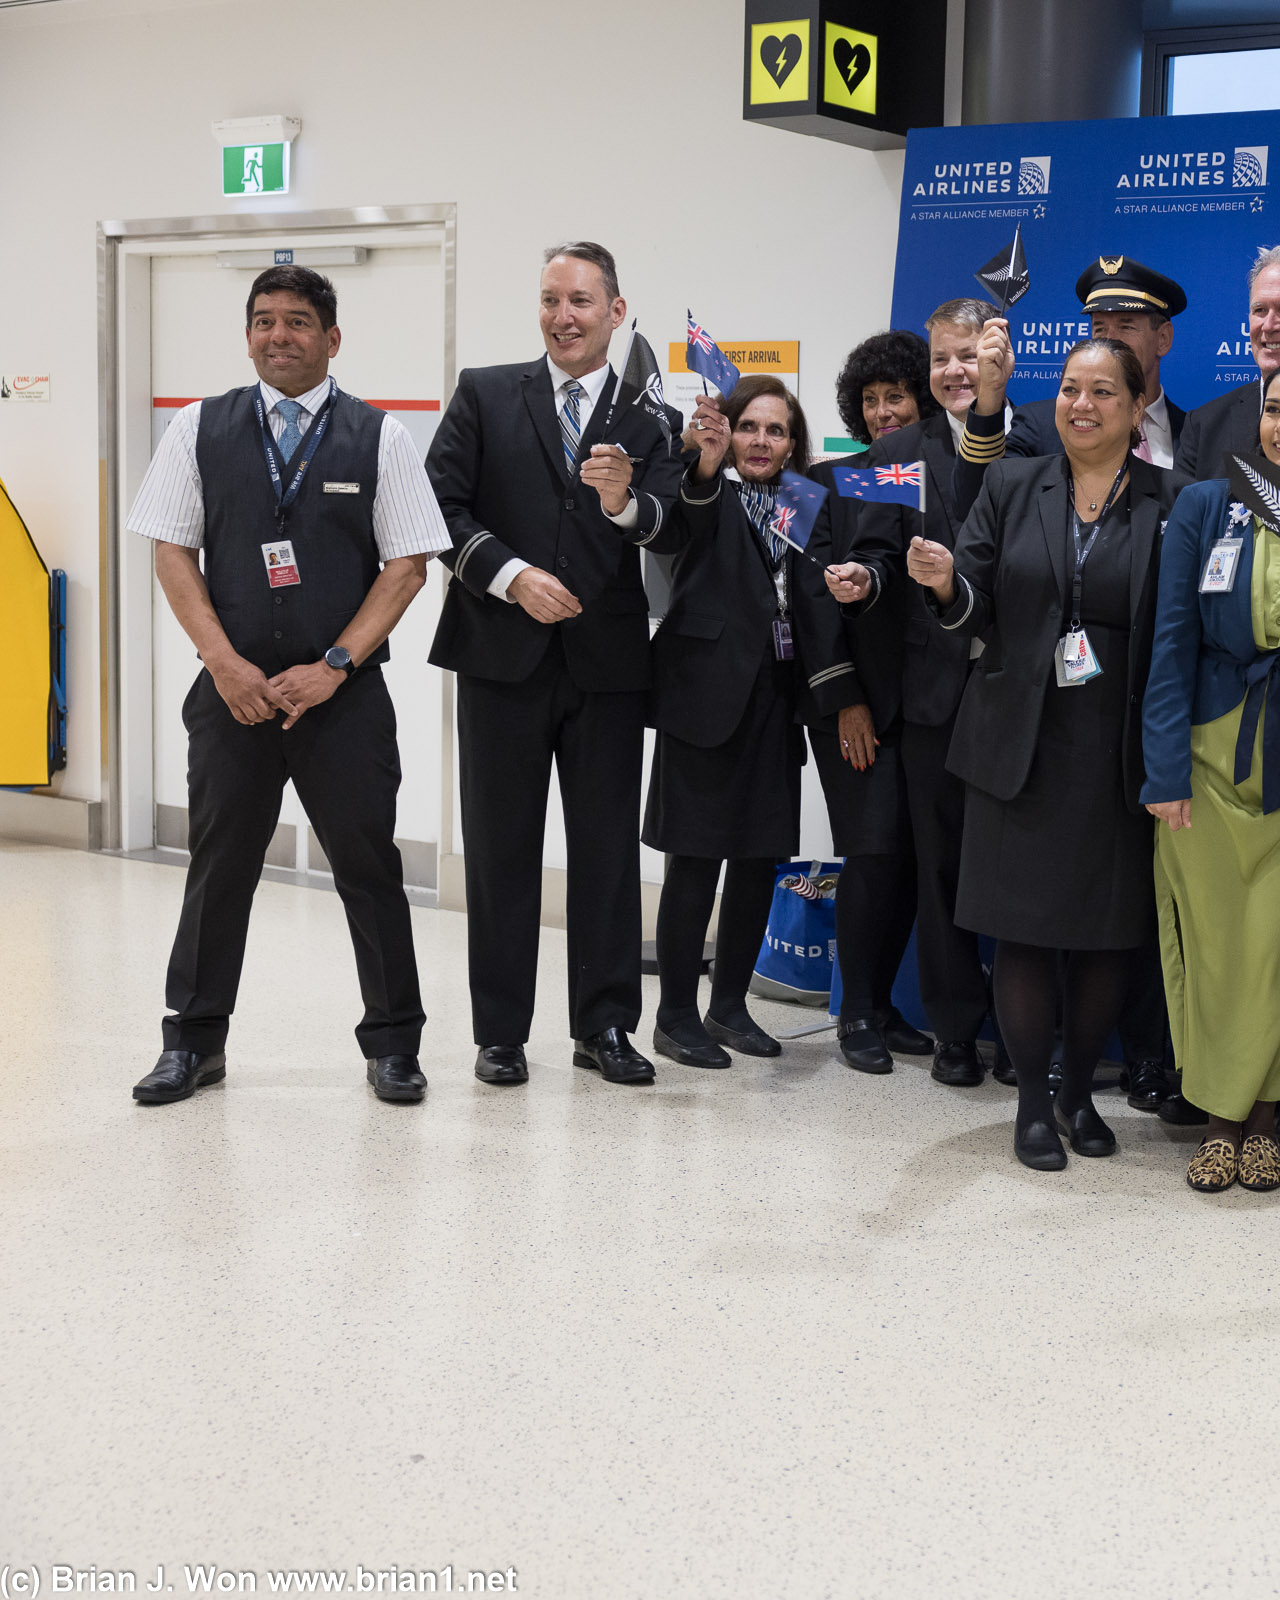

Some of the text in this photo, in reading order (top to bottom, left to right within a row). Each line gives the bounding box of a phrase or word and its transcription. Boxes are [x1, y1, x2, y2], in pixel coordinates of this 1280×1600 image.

[1140, 152, 1226, 169] UNITED
[934, 161, 1013, 178] UNITED
[1116, 170, 1225, 188] AIRLINES
[912, 179, 1012, 196] AIRLINES
[910, 208, 1029, 221] A STAR ALLIANCE MEMBER
[1114, 202, 1245, 214] A STAR ALLIANCE MEMBER
[1022, 322, 1089, 337] UNITE
[1017, 340, 1076, 354] IRLIN
[724, 350, 781, 363] FIRST ARRIVAL
[1033, 370, 1063, 380] ALLIA
[1215, 374, 1221, 382] A
[1224, 373, 1250, 382] STAR
[316, 411, 330, 435] UNITED
[267, 447, 277, 473] UNITED
[290, 479, 299, 490] We
[295, 471, 303, 482] are
